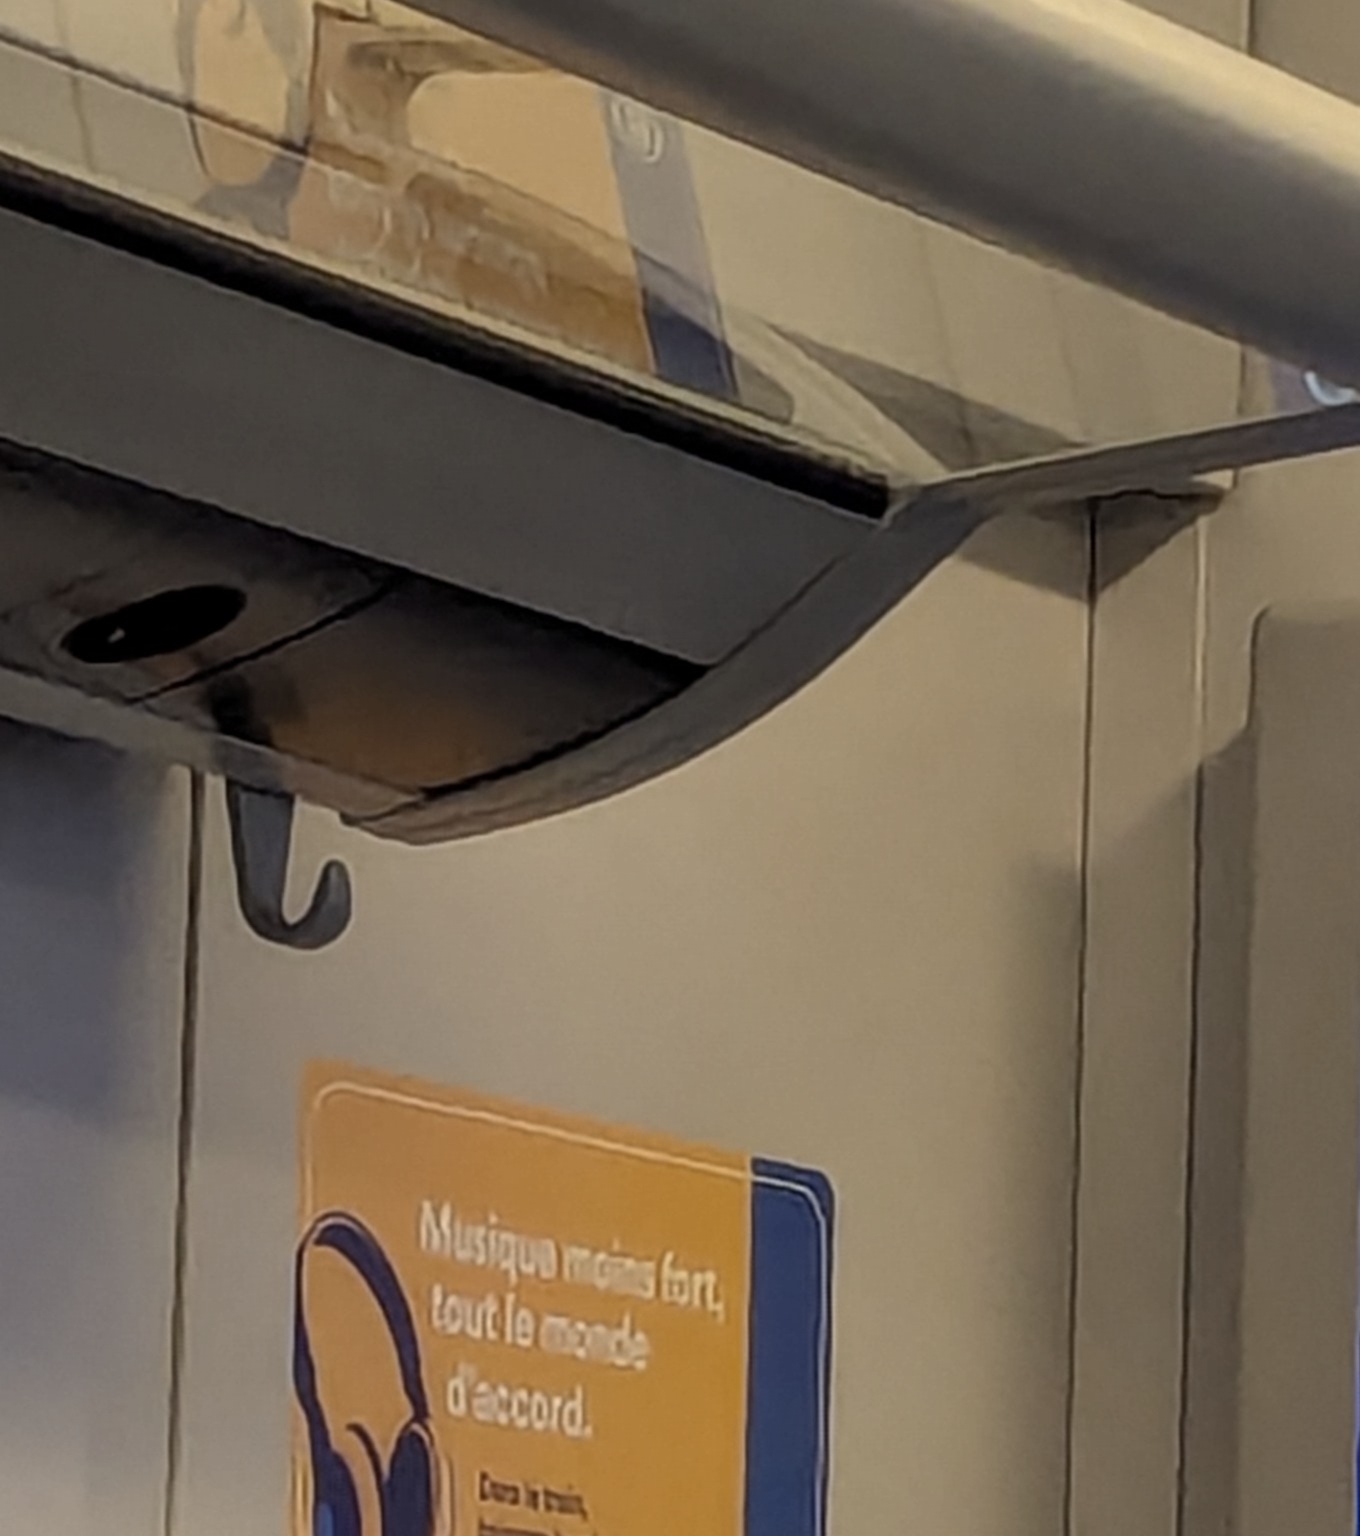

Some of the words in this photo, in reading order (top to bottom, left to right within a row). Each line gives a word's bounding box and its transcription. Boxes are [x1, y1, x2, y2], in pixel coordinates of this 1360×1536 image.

[420, 1199, 557, 1288] Musique
[432, 1283, 500, 1341] tout
[504, 1291, 534, 1348] le
[540, 1308, 650, 1370] monde
